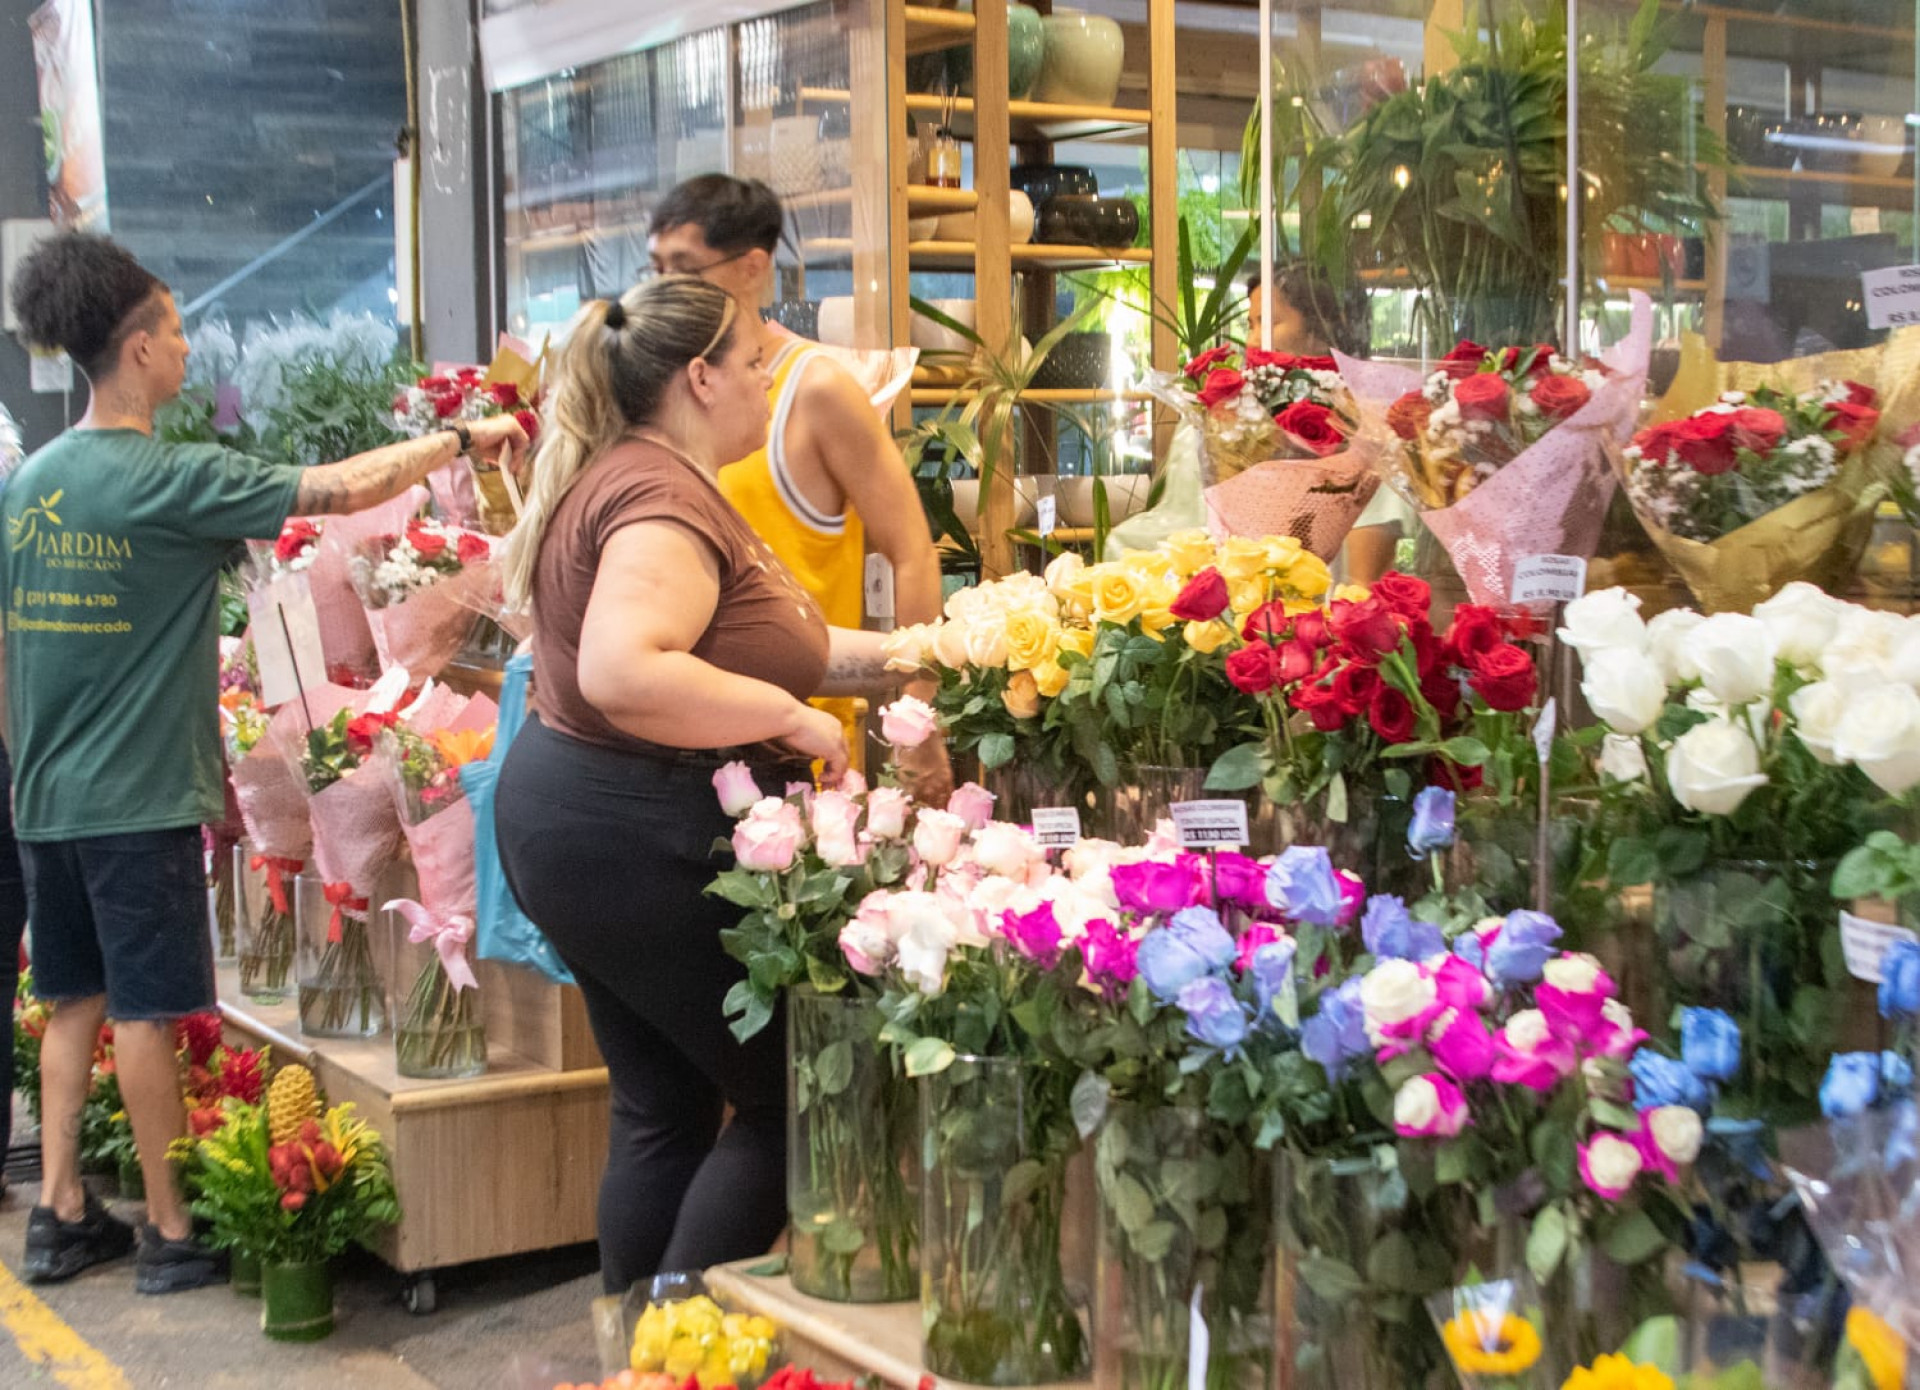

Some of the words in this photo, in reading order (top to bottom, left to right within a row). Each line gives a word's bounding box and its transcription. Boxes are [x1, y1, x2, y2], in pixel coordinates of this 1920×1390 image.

[36, 531, 132, 559] JARDIM
[46, 557, 62, 569] DO
[63, 557, 122, 571] MERCADO
